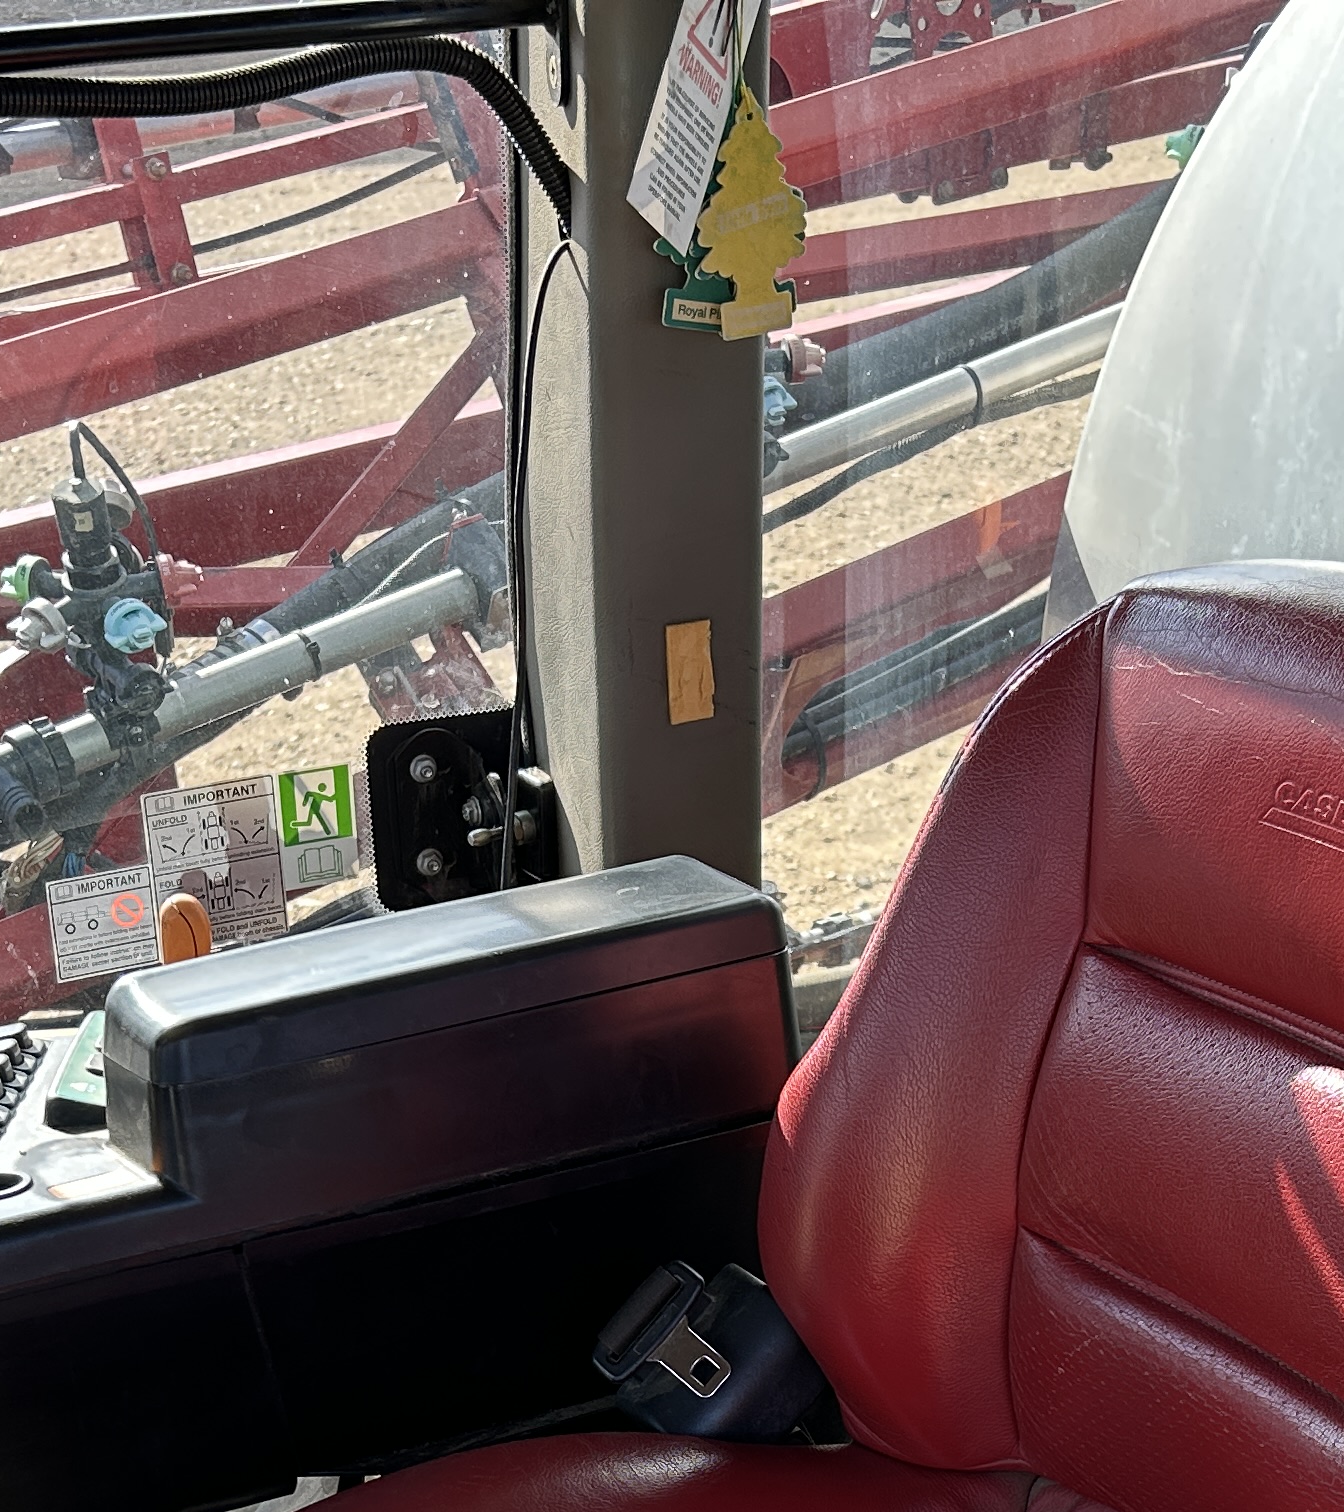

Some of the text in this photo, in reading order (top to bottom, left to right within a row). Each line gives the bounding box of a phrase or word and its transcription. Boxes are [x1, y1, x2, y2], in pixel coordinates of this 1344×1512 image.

[678, 42, 723, 109] WARNING!
[677, 303, 708, 319] Royal
[183, 784, 257, 806] IMPORTANT
[152, 814, 188, 828] UNFOLD
[76, 873, 142, 894] IMPORTANT
[159, 878, 183, 889] FOLD
